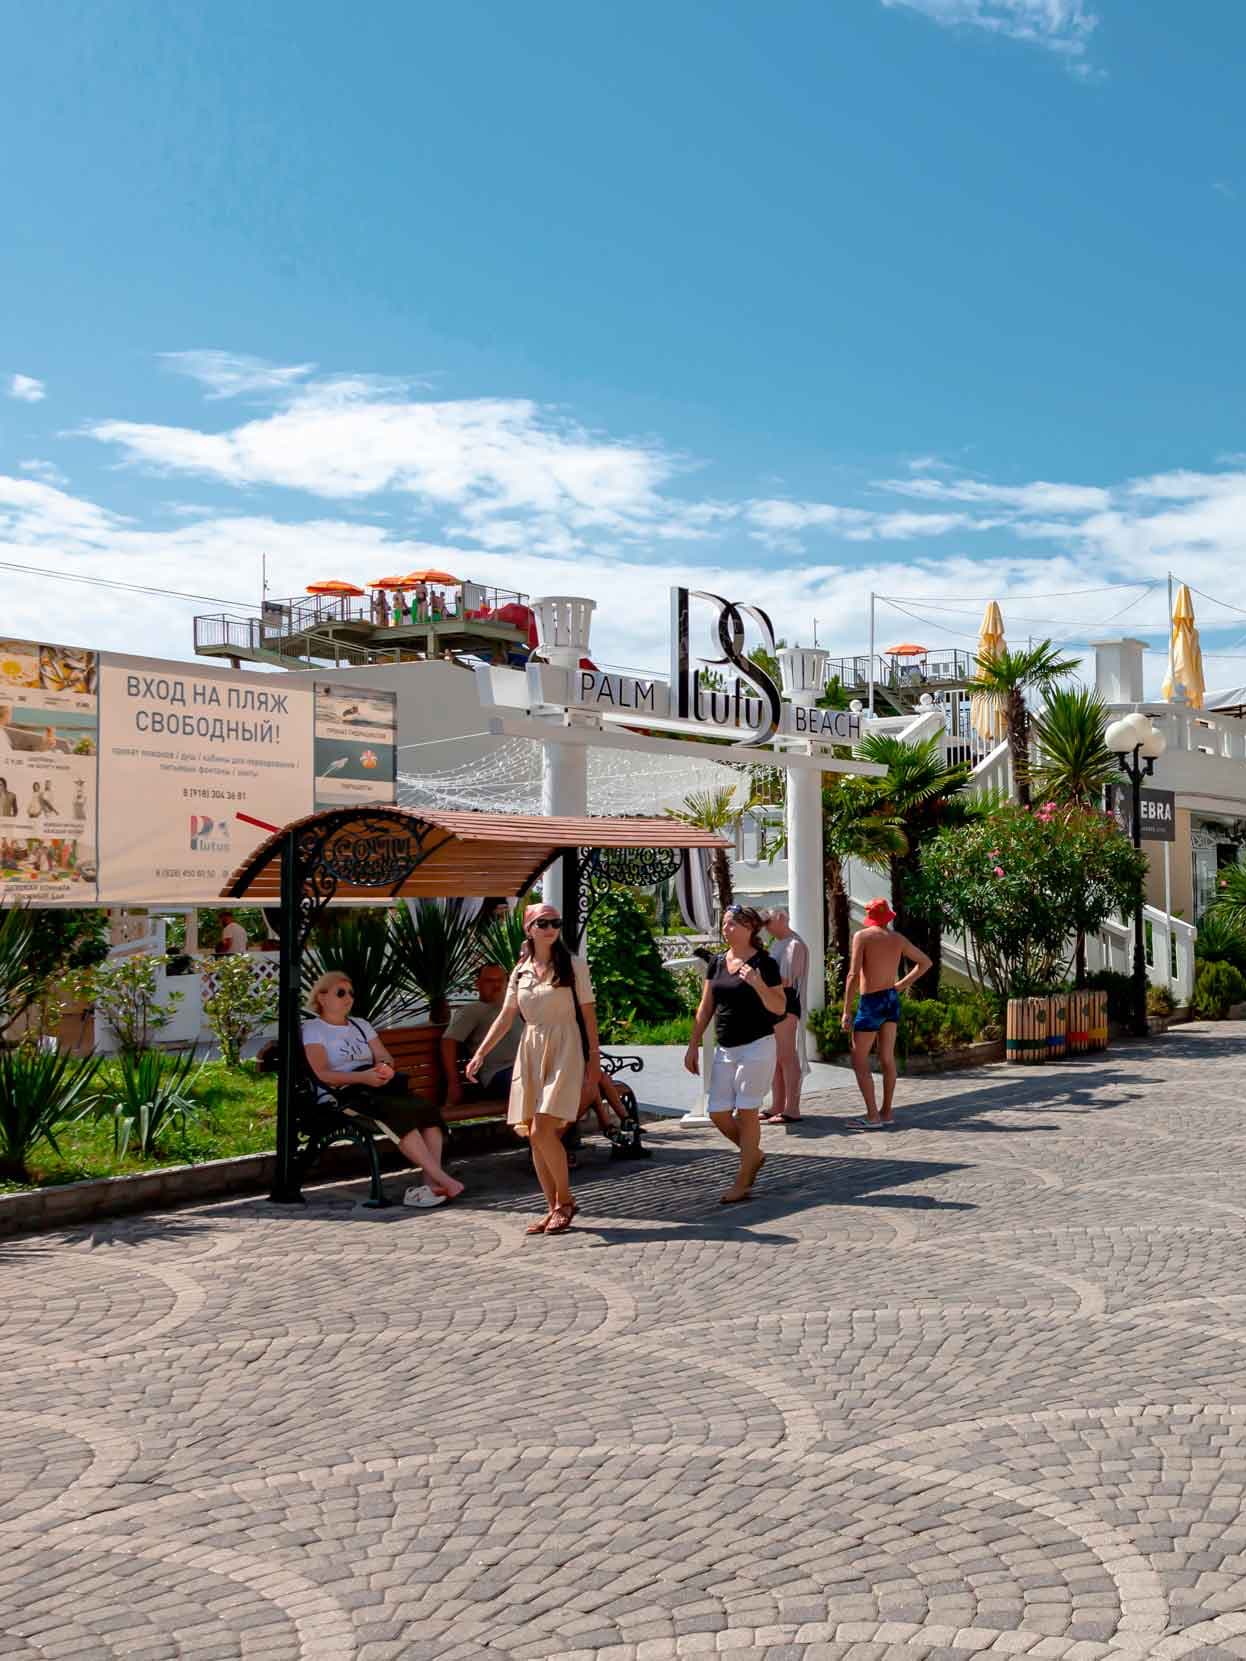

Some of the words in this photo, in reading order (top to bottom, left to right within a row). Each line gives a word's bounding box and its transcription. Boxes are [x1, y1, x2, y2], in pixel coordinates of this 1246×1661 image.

[127, 676, 186, 706] ВХОД
[193, 684, 221, 706] НА
[227, 688, 289, 714] ПЛЯЖ
[580, 672, 655, 711] PALM
[136, 710, 281, 744] СВОБОДНЫЙ!
[795, 706, 860, 738] BEACH
[1139, 800, 1172, 821] EBRA
